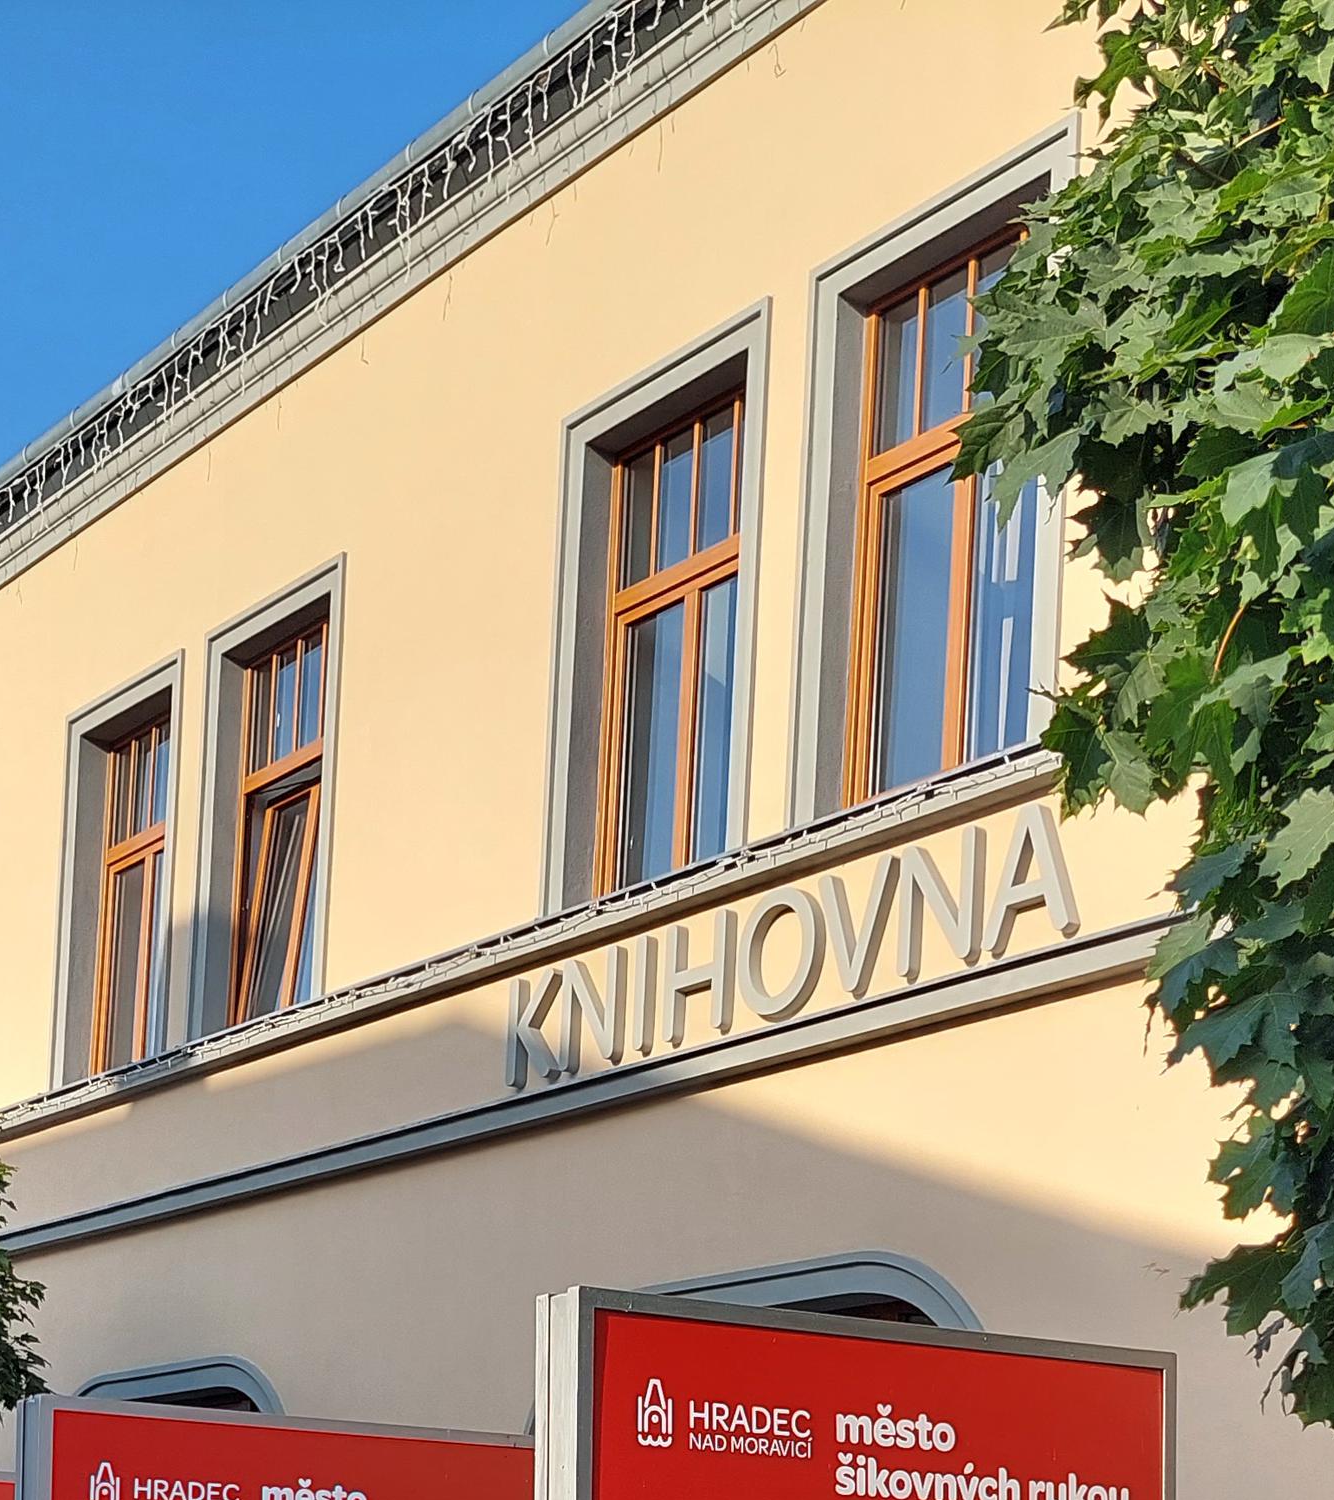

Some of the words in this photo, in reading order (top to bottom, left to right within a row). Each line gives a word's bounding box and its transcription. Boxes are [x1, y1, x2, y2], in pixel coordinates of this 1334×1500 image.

[505, 803, 1082, 1091] KNIHOVNA
[689, 1400, 812, 1438] HRADEC
[835, 1403, 957, 1453] město
[688, 1433, 727, 1454] NAD
[730, 1436, 813, 1459] MORAVICÍ
